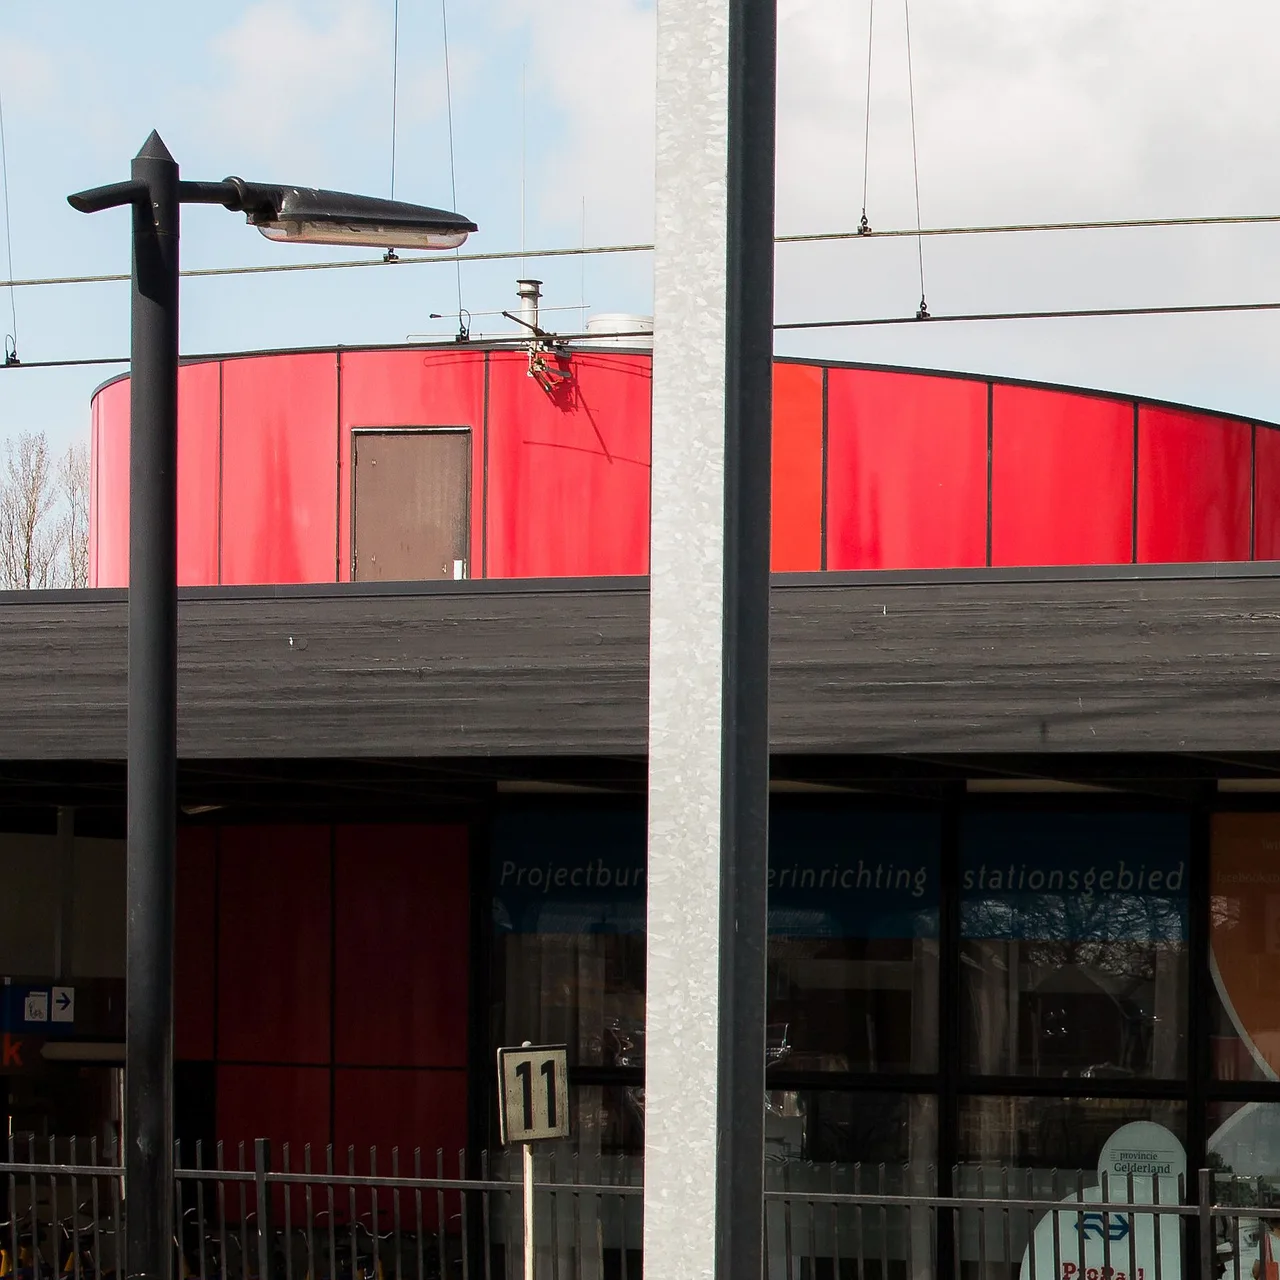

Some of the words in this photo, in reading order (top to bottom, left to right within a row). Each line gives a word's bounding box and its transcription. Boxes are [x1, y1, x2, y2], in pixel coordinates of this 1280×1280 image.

[499, 859, 645, 893] Projectbur
[767, 859, 929, 897] erinrichting
[962, 860, 1184, 894] stationsgebied
[514, 1059, 557, 1130] 11
[1114, 1162, 1171, 1174] Gelderland
[1119, 1151, 1158, 1161] provincie
